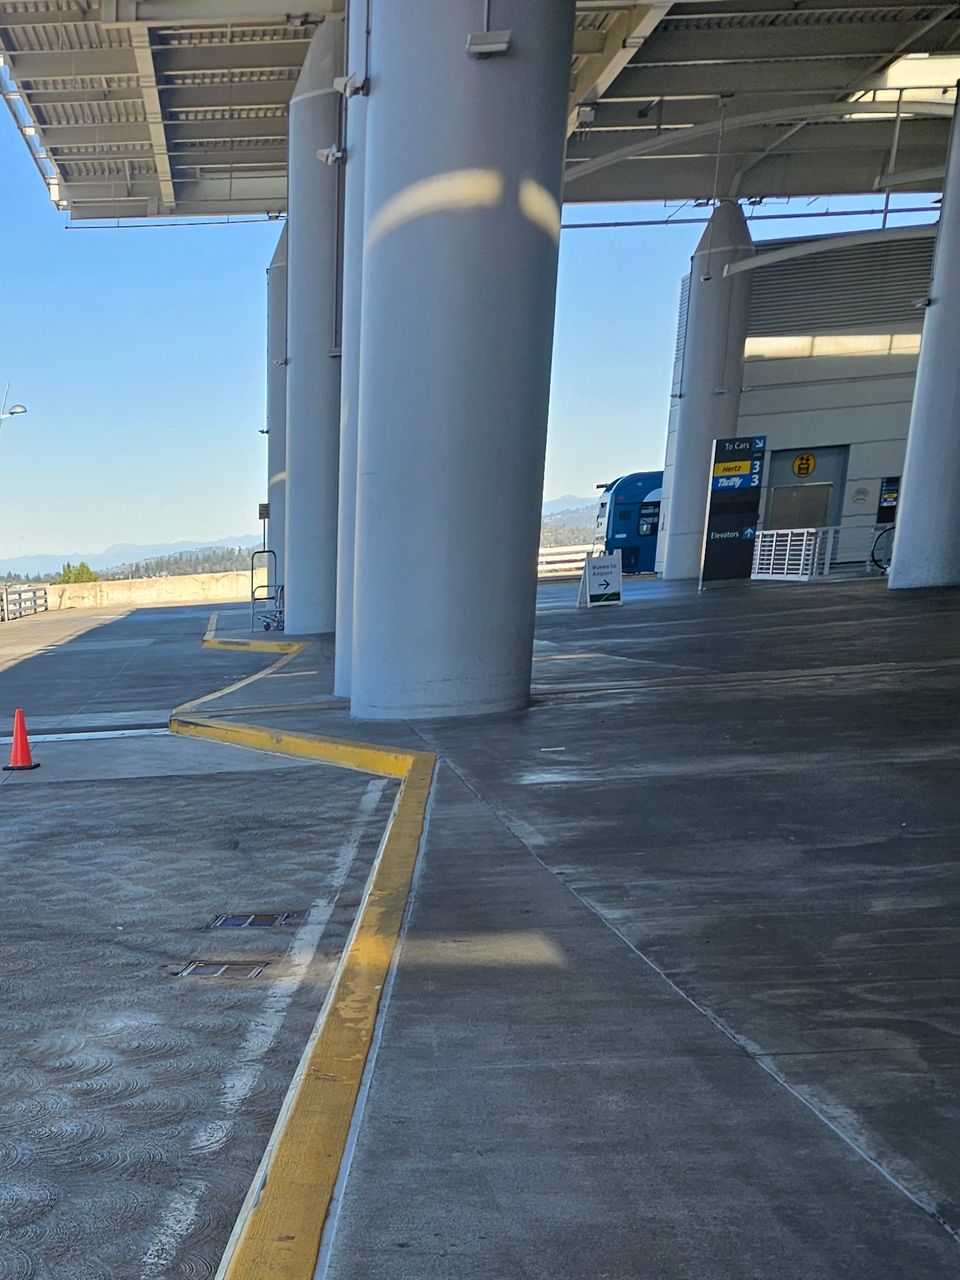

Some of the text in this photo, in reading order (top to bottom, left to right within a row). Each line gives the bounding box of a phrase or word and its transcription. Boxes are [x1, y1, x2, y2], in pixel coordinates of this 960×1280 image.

[725, 441, 750, 450] To Cars
[722, 461, 760, 473] Hertz 3
[718, 474, 759, 488] Thrifty 3
